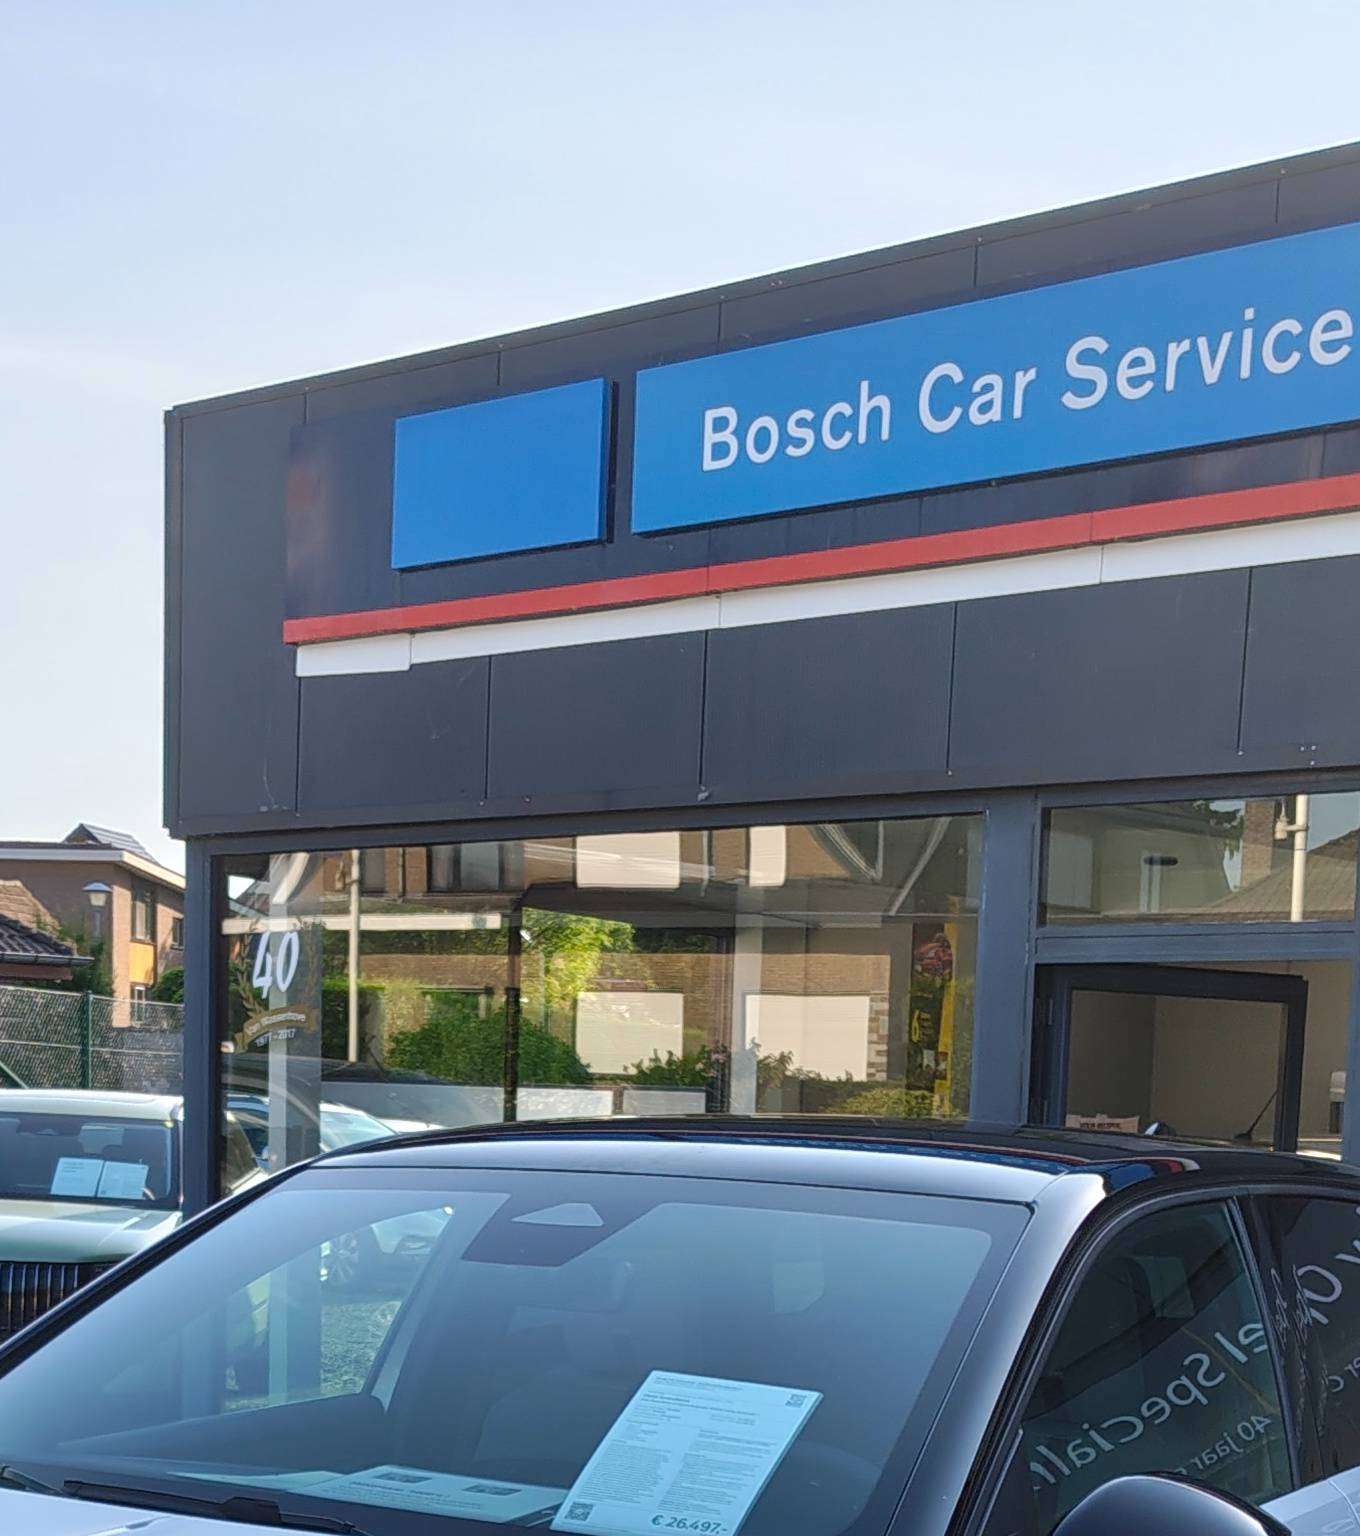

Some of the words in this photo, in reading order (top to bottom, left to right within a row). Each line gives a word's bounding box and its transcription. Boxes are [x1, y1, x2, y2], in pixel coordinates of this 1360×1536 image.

[702, 380, 891, 472] Bosch
[919, 362, 1037, 434] Car
[1061, 307, 1353, 410] Service
[252, 931, 299, 999] 40
